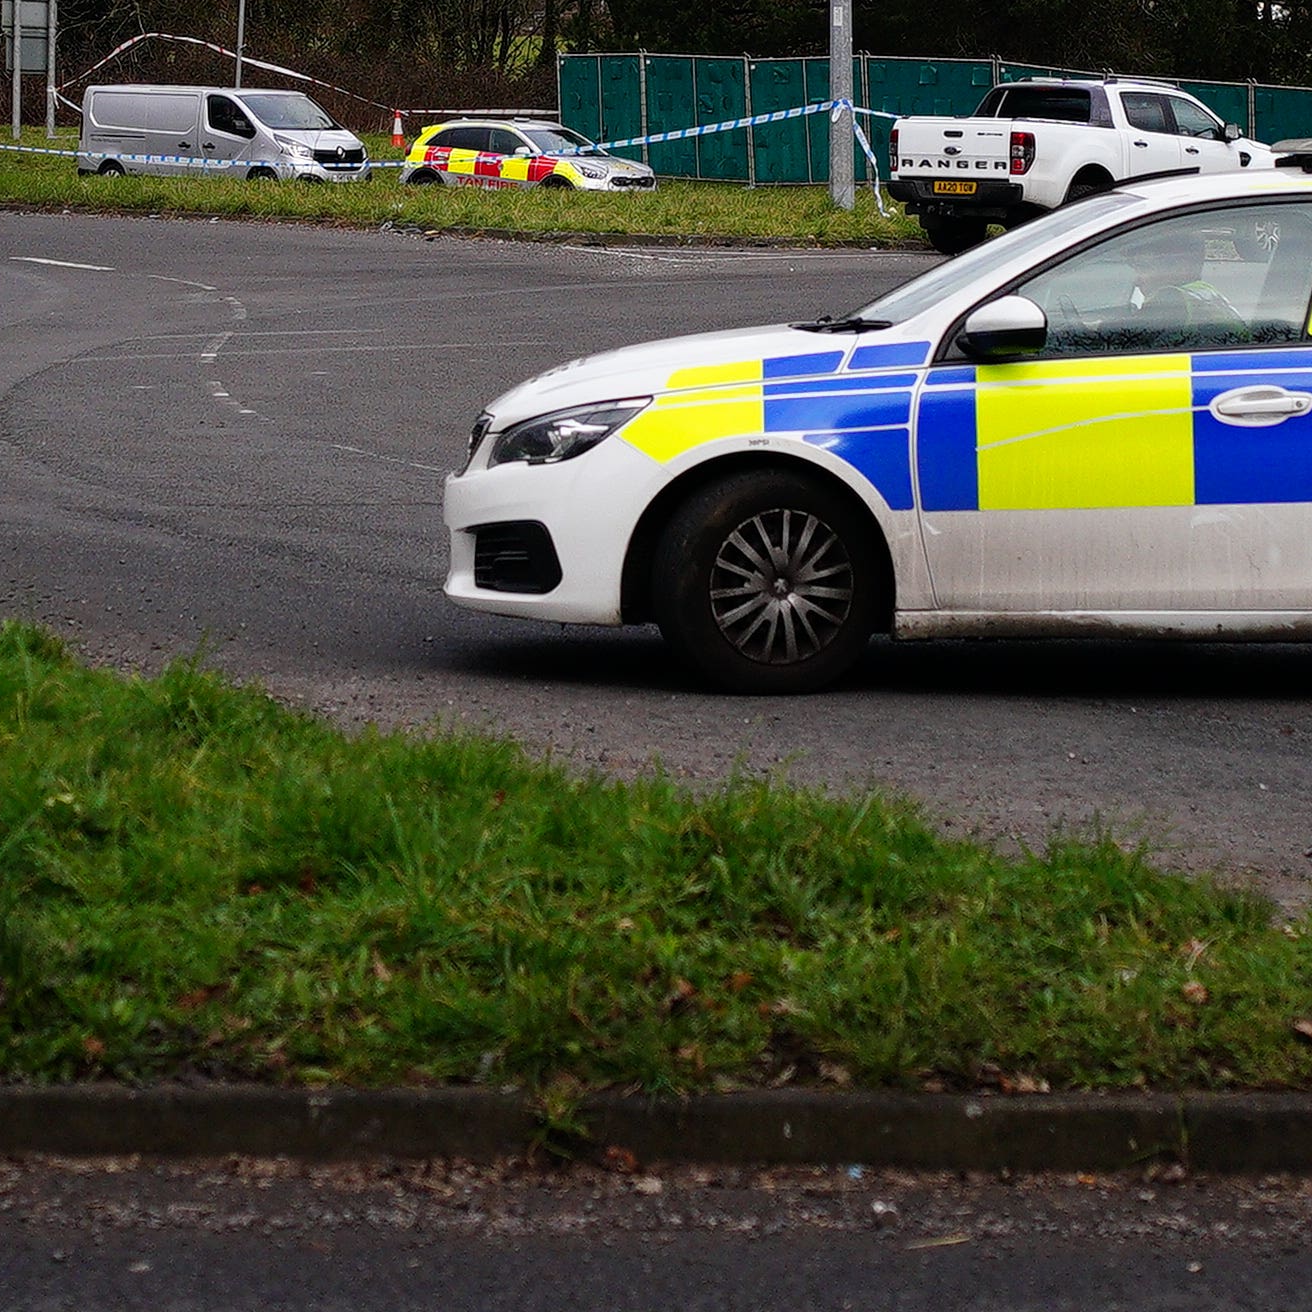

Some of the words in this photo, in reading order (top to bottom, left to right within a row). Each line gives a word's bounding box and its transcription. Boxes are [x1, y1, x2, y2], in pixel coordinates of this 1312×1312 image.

[901, 158, 1007, 170] RANGER
[457, 176, 484, 187] TAN
[936, 182, 957, 192] AA20
